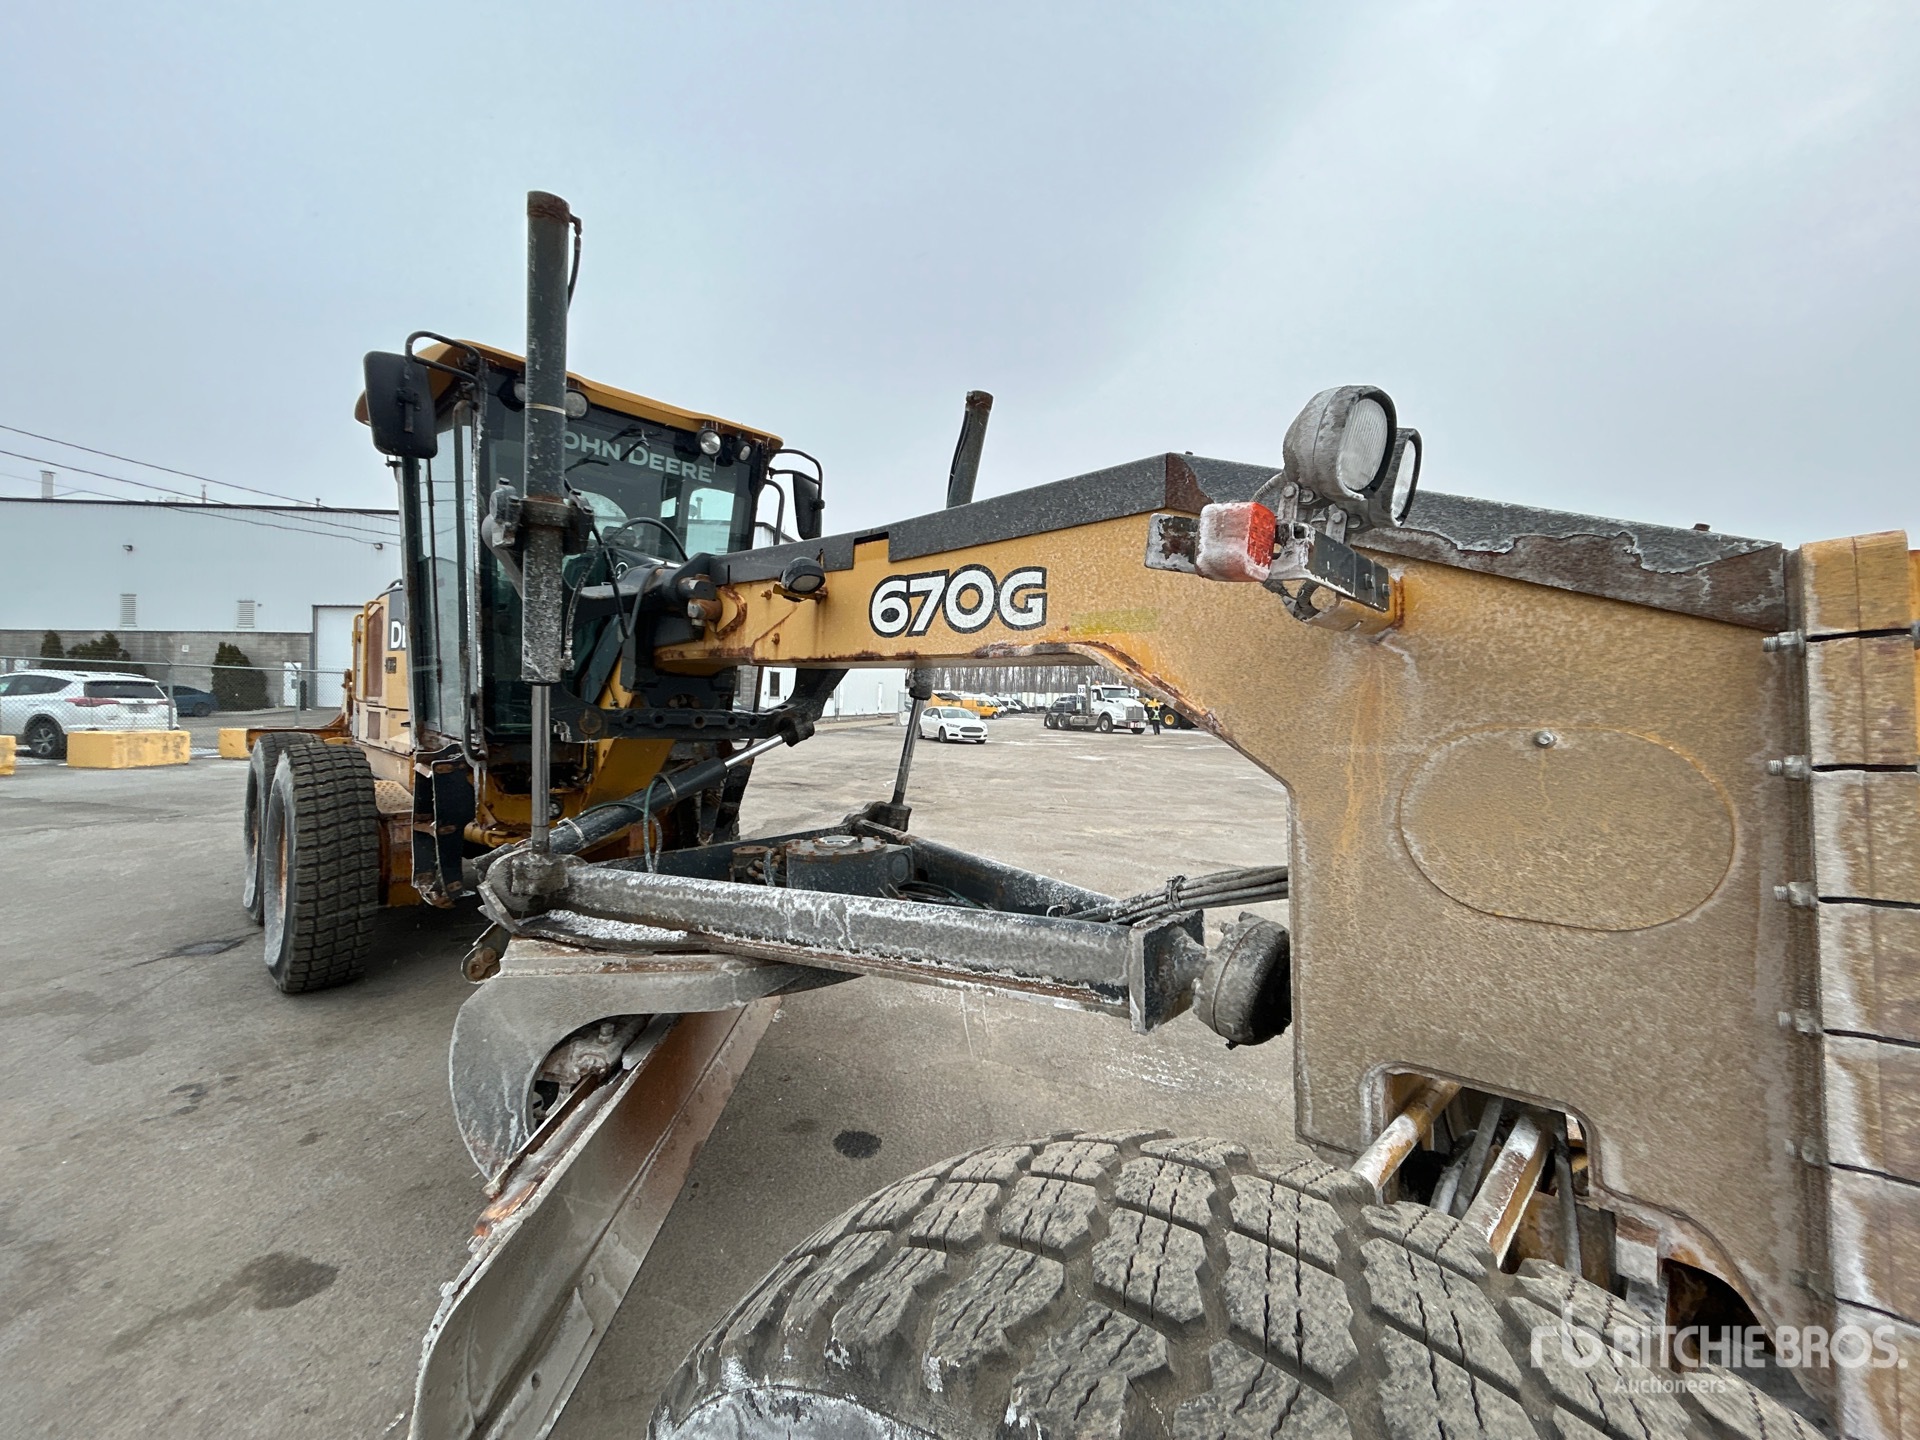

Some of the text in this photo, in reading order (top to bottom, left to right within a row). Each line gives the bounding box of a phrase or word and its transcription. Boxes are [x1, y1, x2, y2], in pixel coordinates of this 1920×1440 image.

[563, 431, 713, 483] OHN DEERE
[868, 563, 1048, 638] 670G
